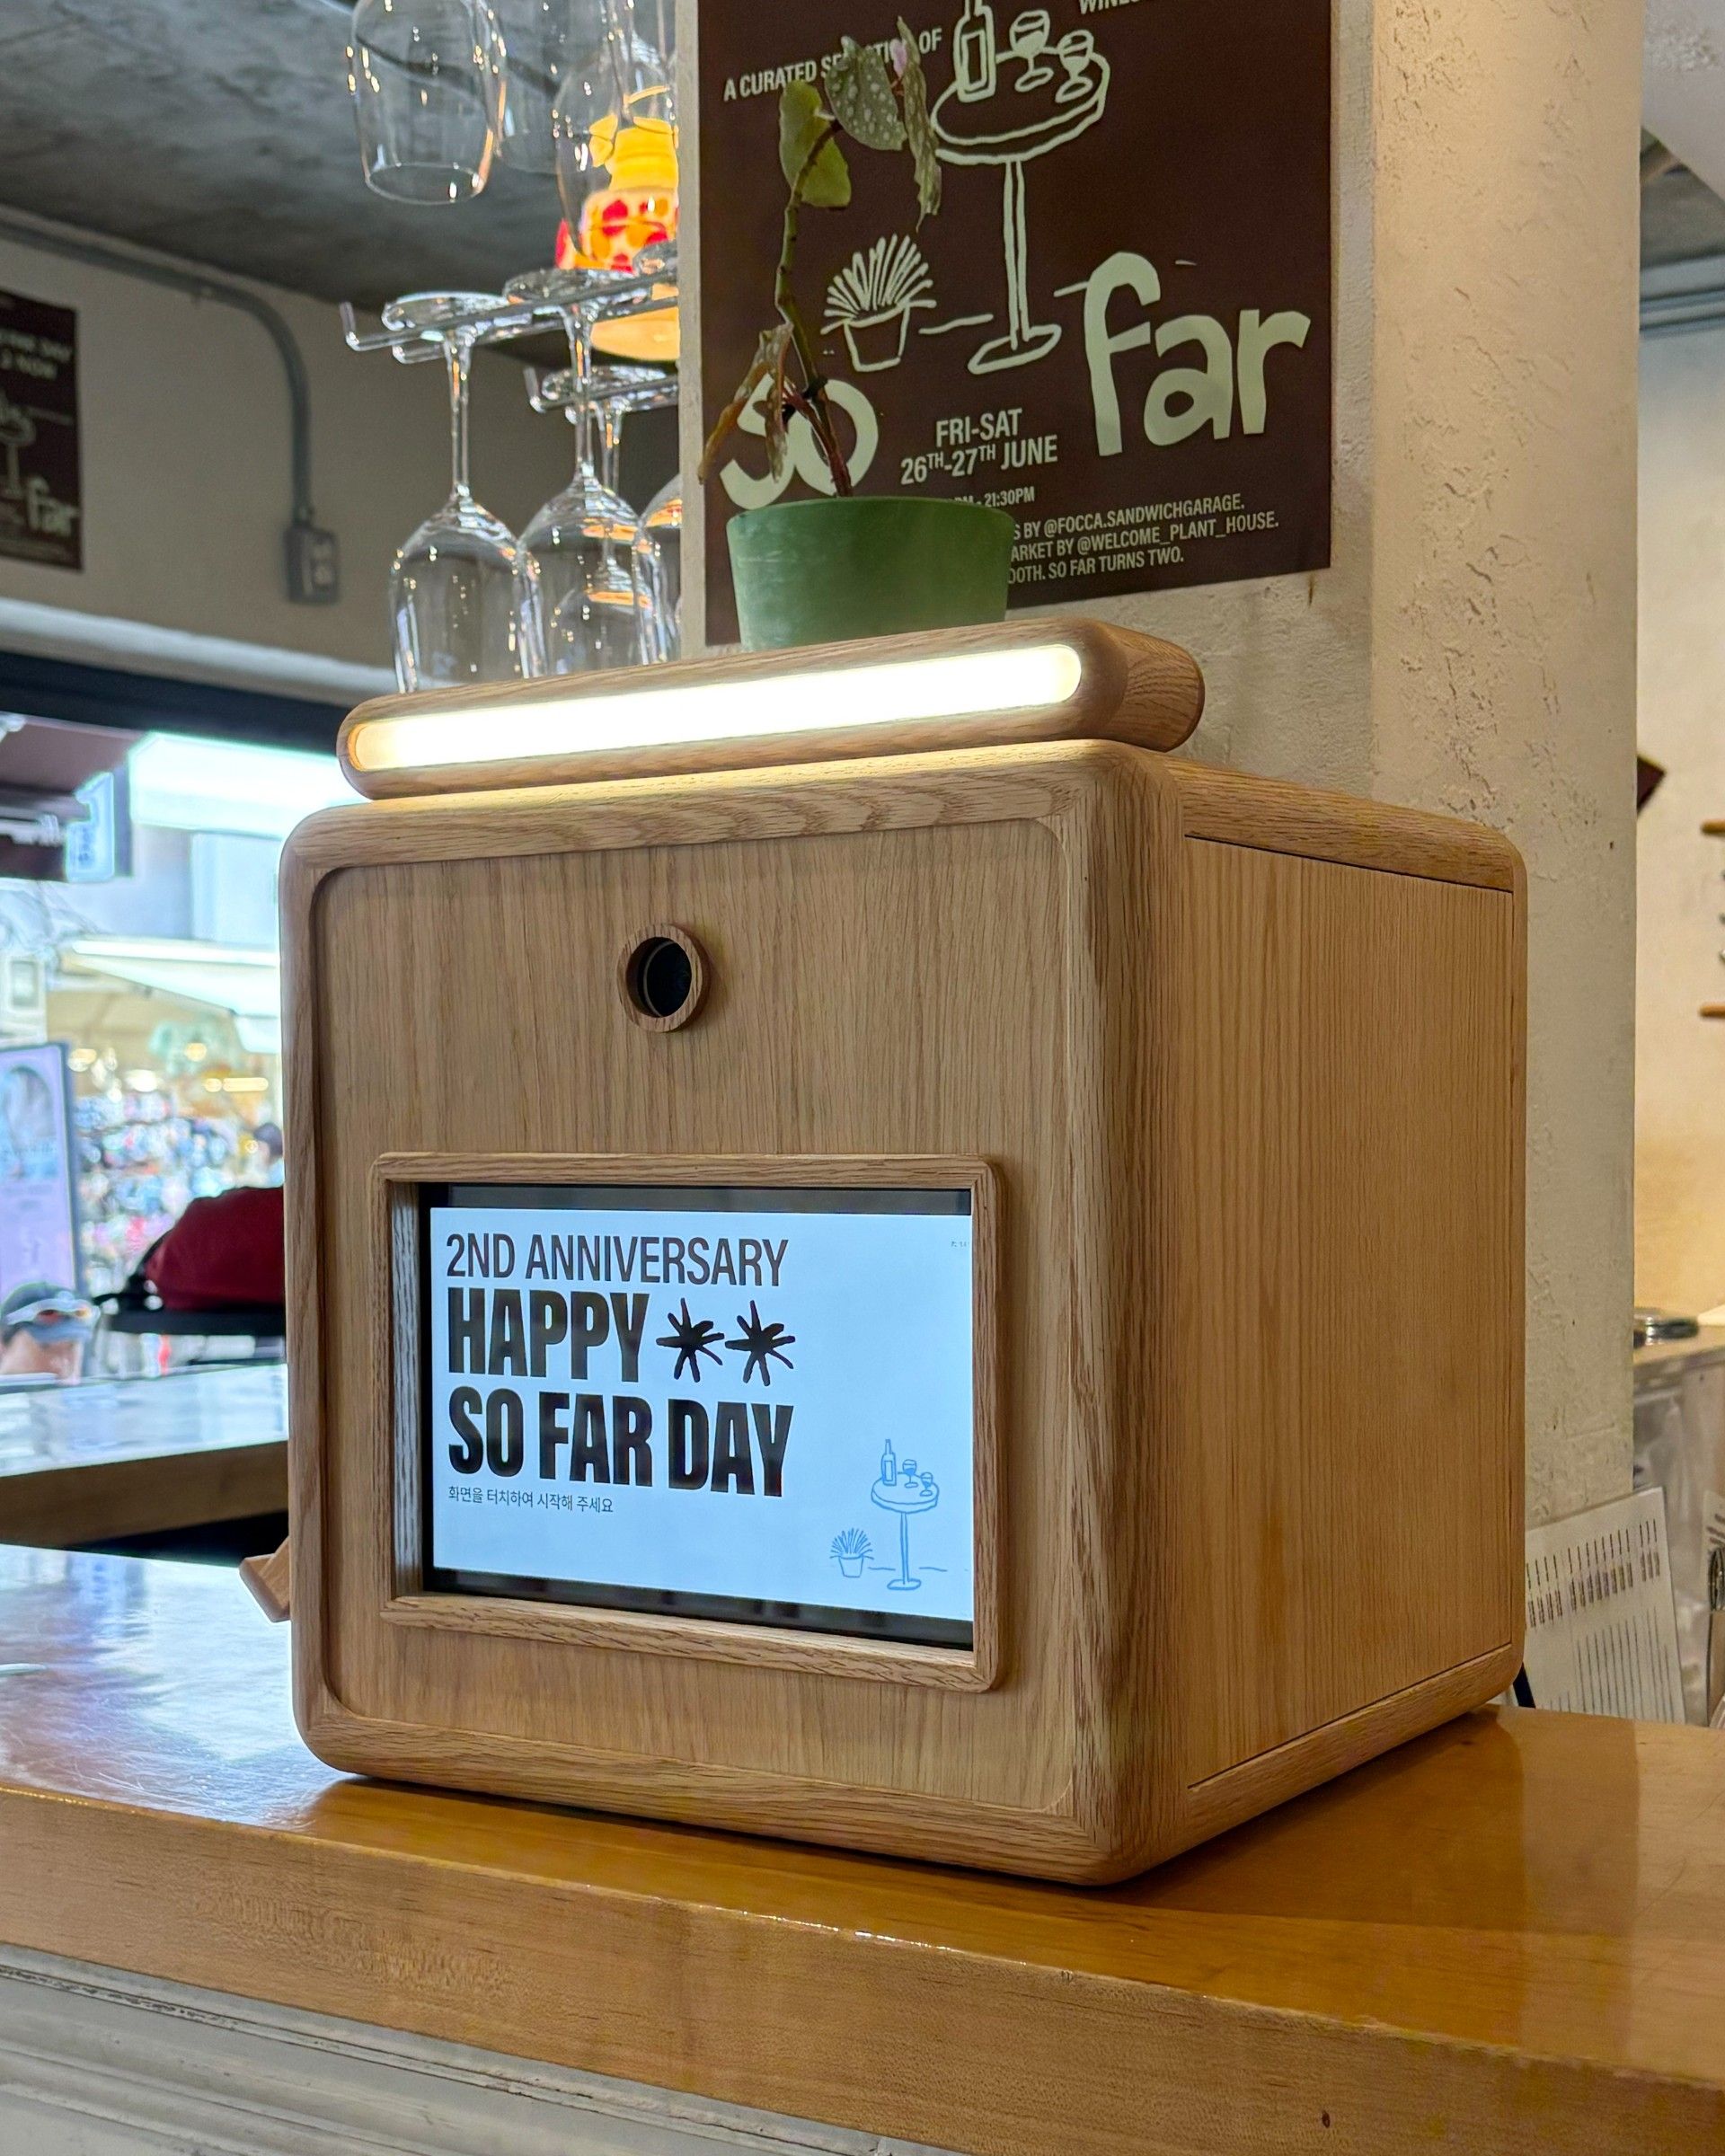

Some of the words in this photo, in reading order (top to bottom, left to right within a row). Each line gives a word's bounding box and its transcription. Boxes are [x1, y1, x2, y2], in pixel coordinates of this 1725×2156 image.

[723, 78, 737, 102] A
[739, 60, 817, 98] CURATED
[918, 28, 942, 54] OF
[1085, 252, 1312, 457] far
[936, 408, 1022, 447] FRI-SAT
[900, 443, 996, 485] 26TH-27TH
[1000, 435, 1057, 470] JUNE
[985, 486, 1035, 508] 21:30PM
[1023, 520, 1040, 539] BY
[1044, 493, 1245, 538] @FOCCA.SANDWICHGARAGE.
[1011, 541, 1053, 561] ARKET
[1057, 538, 1074, 556] BY
[1077, 511, 1279, 555] @WELCOME_PLANT_HOUSE.
[1008, 565, 1046, 583] OOTH.
[1048, 561, 1066, 579] SO
[1070, 558, 1095, 576] FAR
[1099, 551, 1145, 572] TURNS
[1147, 546, 1184, 566] TWO.
[447, 1233, 515, 1279] 2ND
[526, 1234, 789, 1286] ANNIVERSARY
[448, 1287, 650, 1383] HAPPY
[448, 1385, 525, 1478] SO
[539, 1392, 654, 1488] FAR
[668, 1398, 794, 1498] DAY
[448, 1486, 483, 1504] 화면을
[487, 1489, 534, 1508] 터치하여
[537, 1493, 573, 1511] 시작해
[576, 1496, 614, 1513] 주세요
